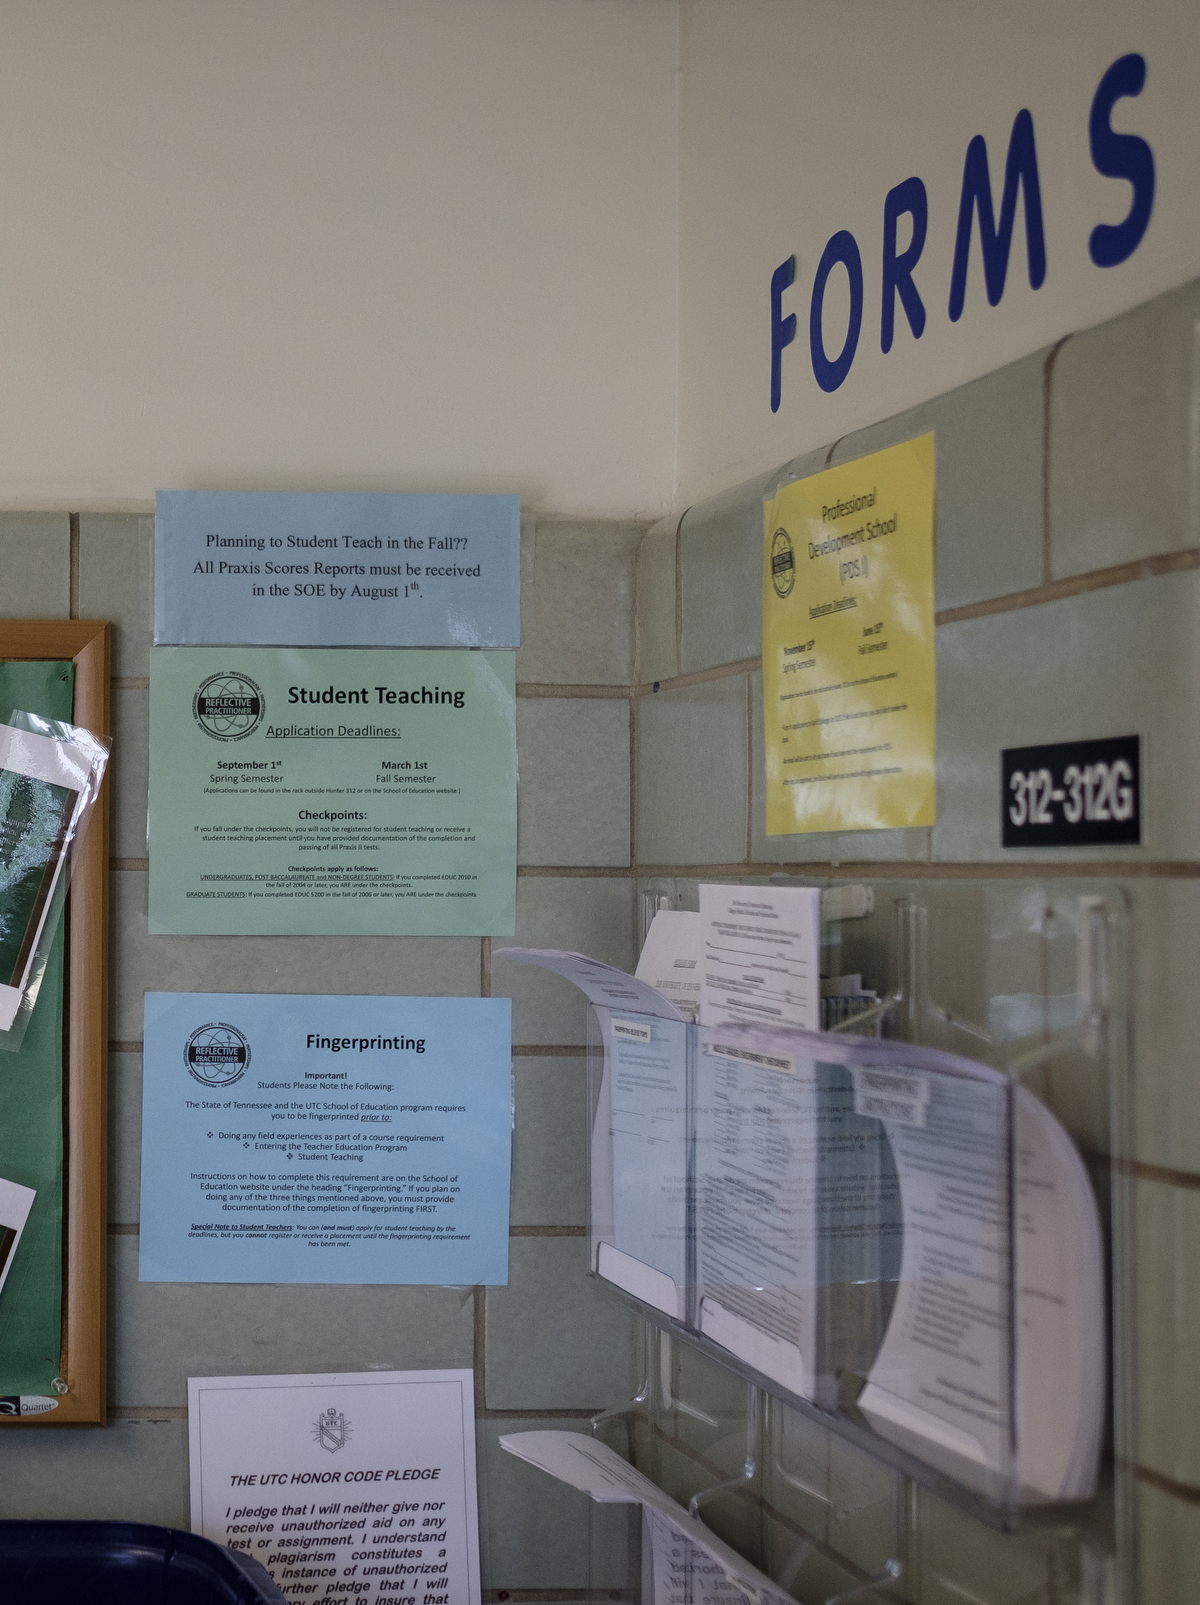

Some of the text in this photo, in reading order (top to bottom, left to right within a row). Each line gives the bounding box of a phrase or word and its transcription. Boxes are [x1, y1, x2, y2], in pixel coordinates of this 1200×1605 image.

[771, 53, 1156, 413] FORMS
[821, 487, 877, 523] Professional
[205, 534, 468, 551] Planning to Student Teach in the Fall??
[807, 512, 898, 560] Development School
[192, 560, 481, 578] All Praxis Scores Reports must be received
[252, 583, 265, 596] in
[269, 583, 290, 596] the
[293, 583, 326, 596] SOE
[329, 583, 347, 600] by
[350, 584, 399, 600] August
[205, 698, 252, 707] REFLECTIVE
[288, 686, 465, 708] Student Teaching
[205, 707, 252, 715] PRACTITIONER
[266, 724, 402, 739] Application Deadlines:
[216, 760, 268, 770] September
[381, 760, 428, 770] March 1st
[209, 774, 283, 784] Spring Semester
[375, 774, 436, 783] Fall Semester
[1009, 760, 1134, 826] 312-312G
[298, 809, 367, 821] Checkpoints:
[326, 865, 345, 873] apply
[306, 1034, 426, 1053] Fingerprinting
[195, 1046, 239, 1056] REFLECTIVE
[195, 1055, 239, 1064] PRACTITIONER
[304, 1071, 347, 1080] Important!
[257, 1081, 394, 1092] Students Please Note the Following:
[185, 1100, 466, 1113] The State of Tennessee and the UTC School of Education program requires
[270, 1112, 393, 1123] you to be fingerprinted prior to:
[254, 1141, 408, 1153] Entering the Teacher Education Program
[297, 1152, 364, 1162] Student Teaching
[20, 1402, 52, 1412] Quartet
[230, 1468, 441, 1486] THE UTC HONOR CODE PLEDGE
[225, 1501, 445, 1520] I pledge that I will neither give nor
[225, 1516, 446, 1534] receive unauthorized aid on any
[226, 1531, 447, 1549] test or assignment. I understand
[266, 1548, 446, 1566] plagiarism constitutes a
[281, 1562, 448, 1578] instance of unauthorized
[325, 1580, 371, 1595] pledge
[379, 1579, 405, 1591] that
[412, 1578, 418, 1589] I
[426, 1577, 449, 1589] will
